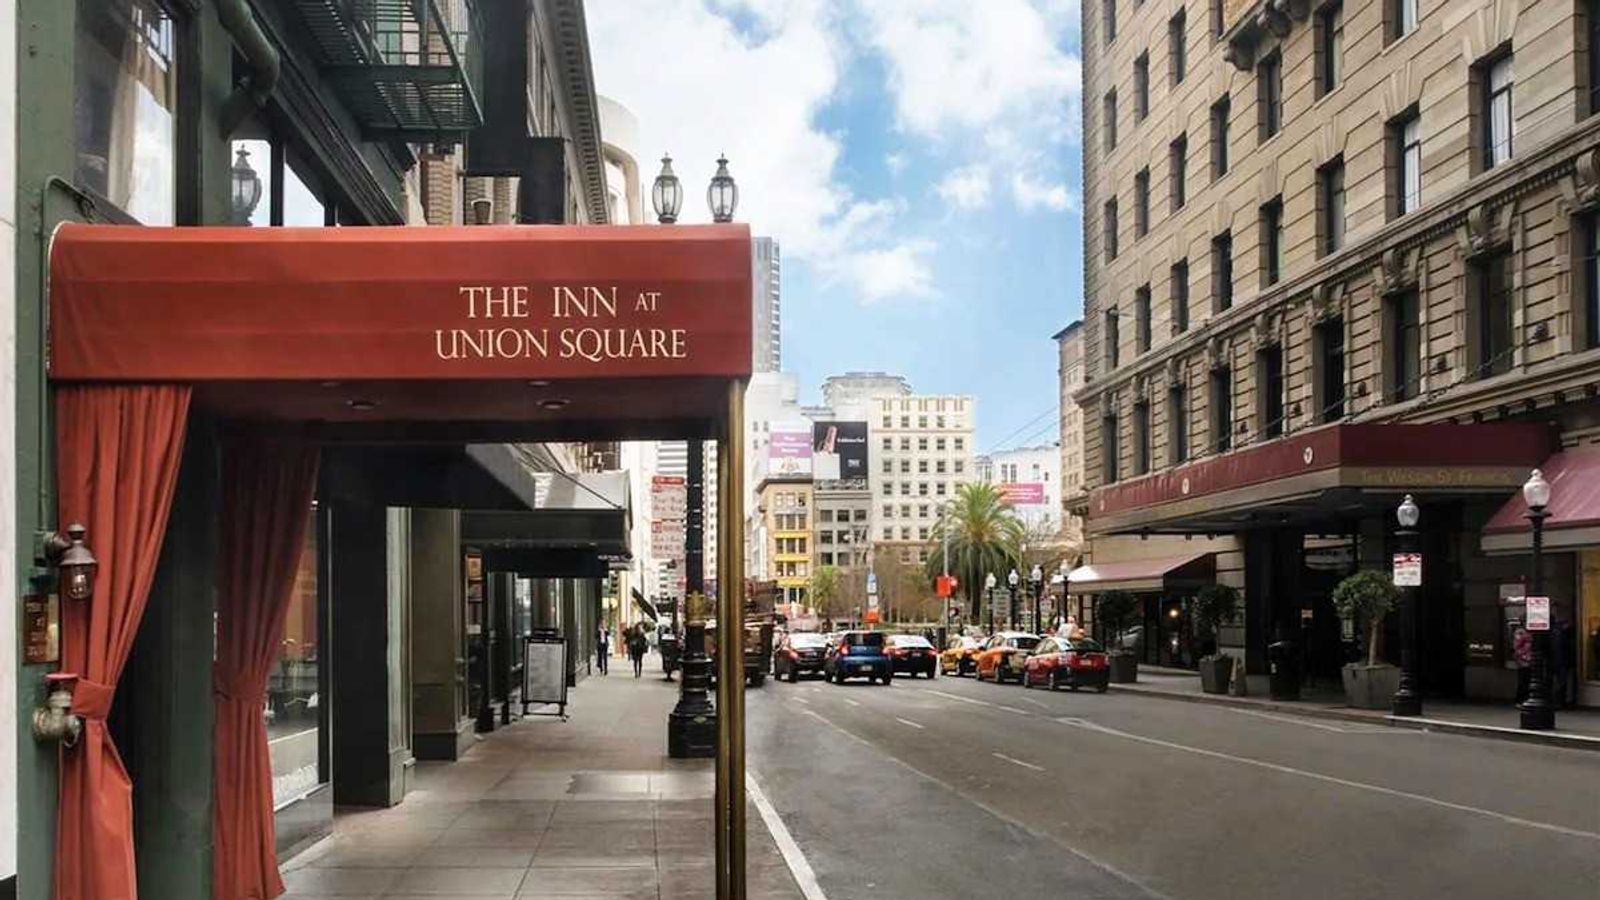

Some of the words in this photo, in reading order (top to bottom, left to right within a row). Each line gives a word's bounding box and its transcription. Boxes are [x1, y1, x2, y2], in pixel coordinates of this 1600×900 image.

[459, 286, 529, 318] THE
[552, 286, 617, 318] INN
[635, 292, 661, 311] AT
[435, 328, 548, 359] UNION
[559, 328, 687, 362] SQUARE
